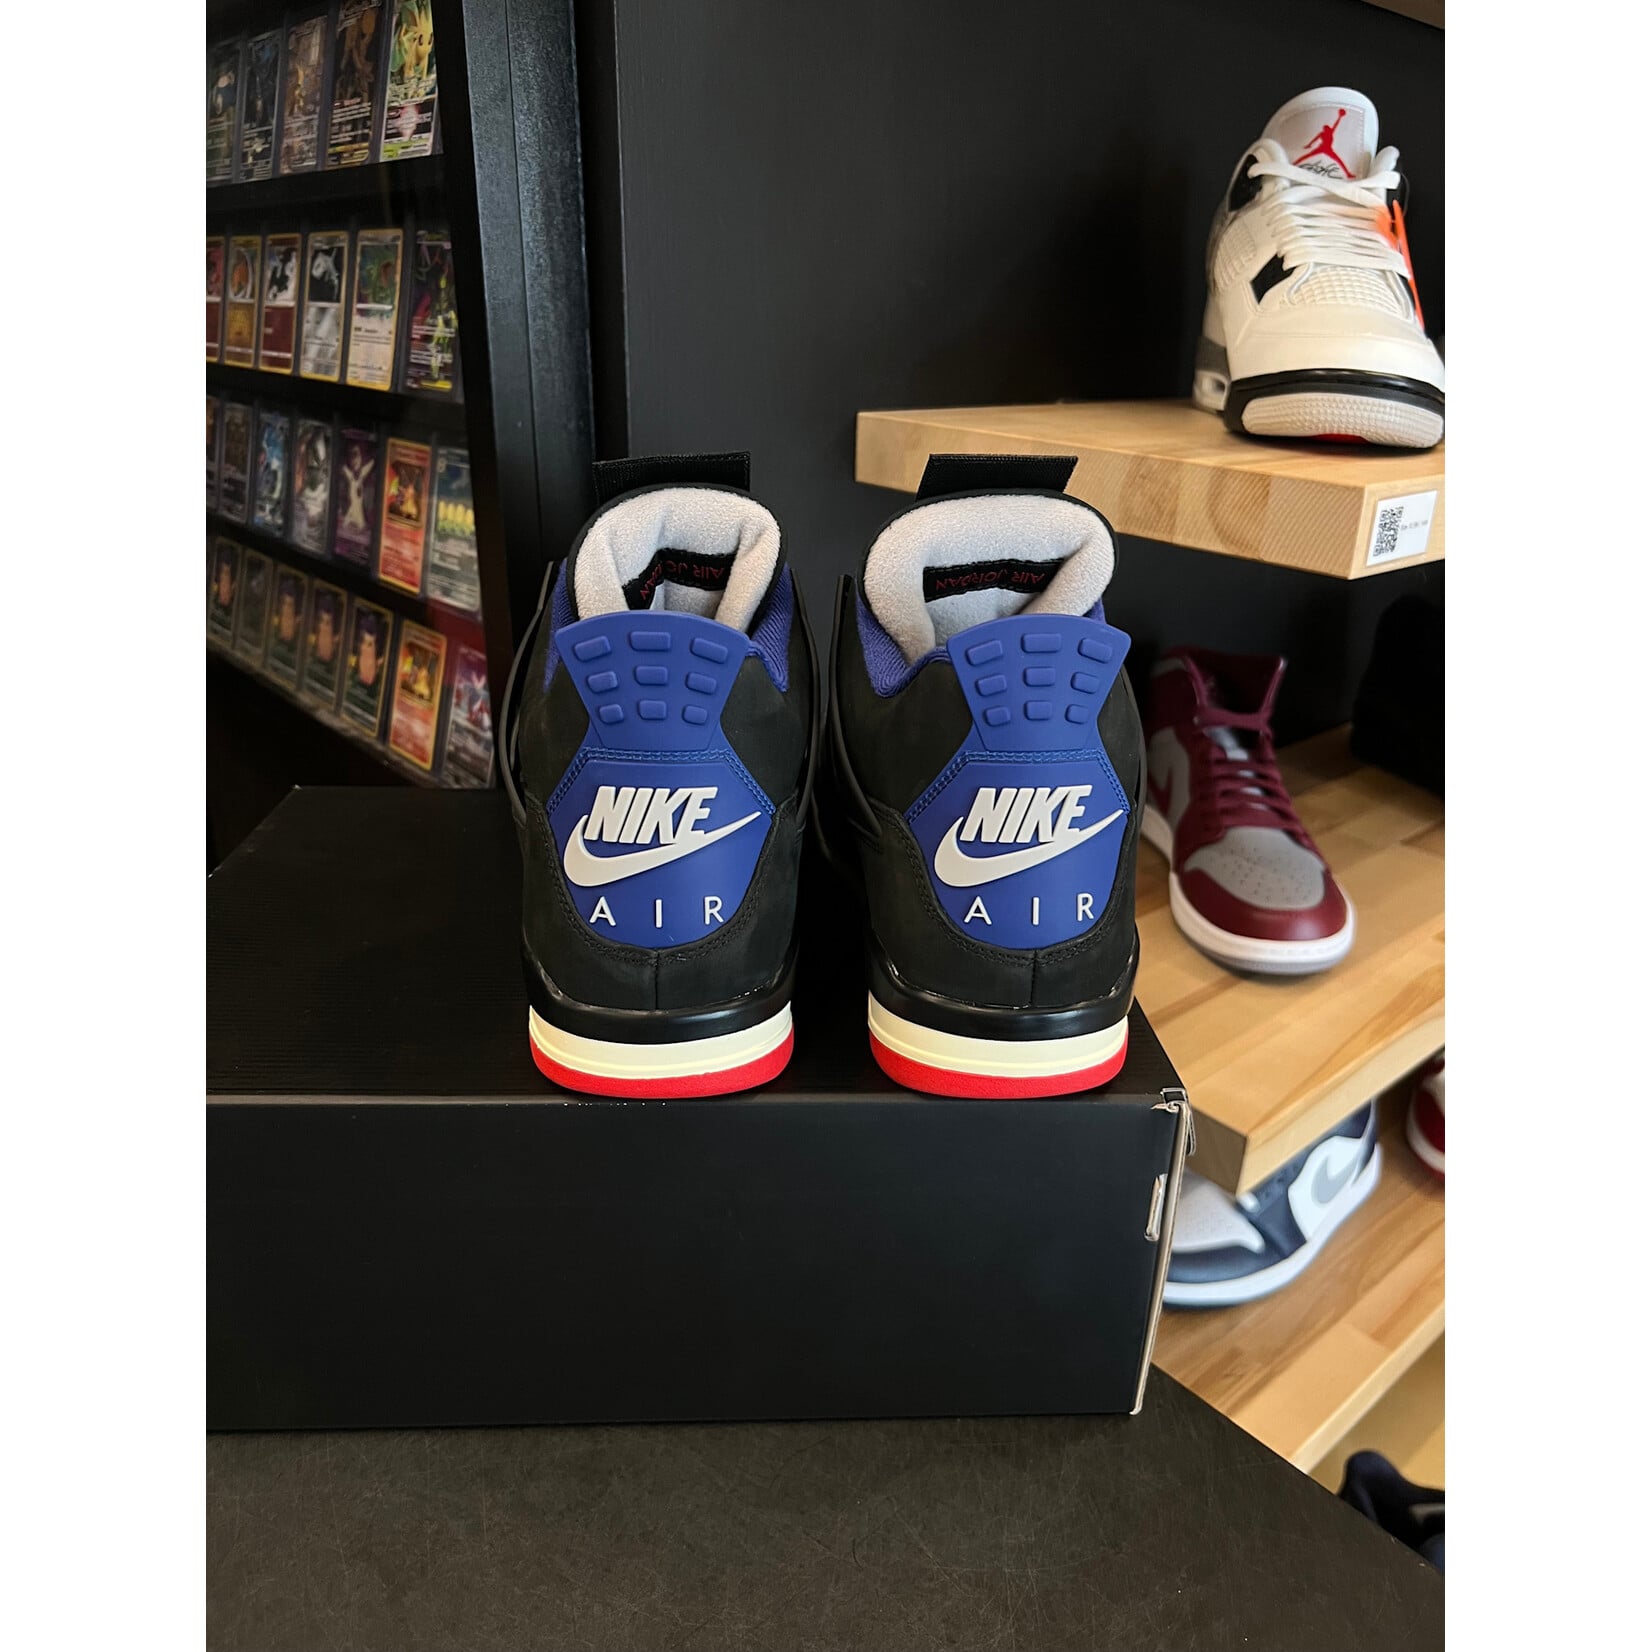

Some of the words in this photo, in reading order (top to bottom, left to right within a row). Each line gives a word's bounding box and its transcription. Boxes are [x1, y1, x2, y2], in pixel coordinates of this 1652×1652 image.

[693, 564, 724, 580] AIR
[936, 568, 1008, 591] JORDAN
[1011, 571, 1046, 585] AIR
[584, 786, 718, 844] NIKE
[960, 785, 1093, 843] NIKE
[589, 896, 724, 928] AIR
[964, 893, 1094, 925] AIR
